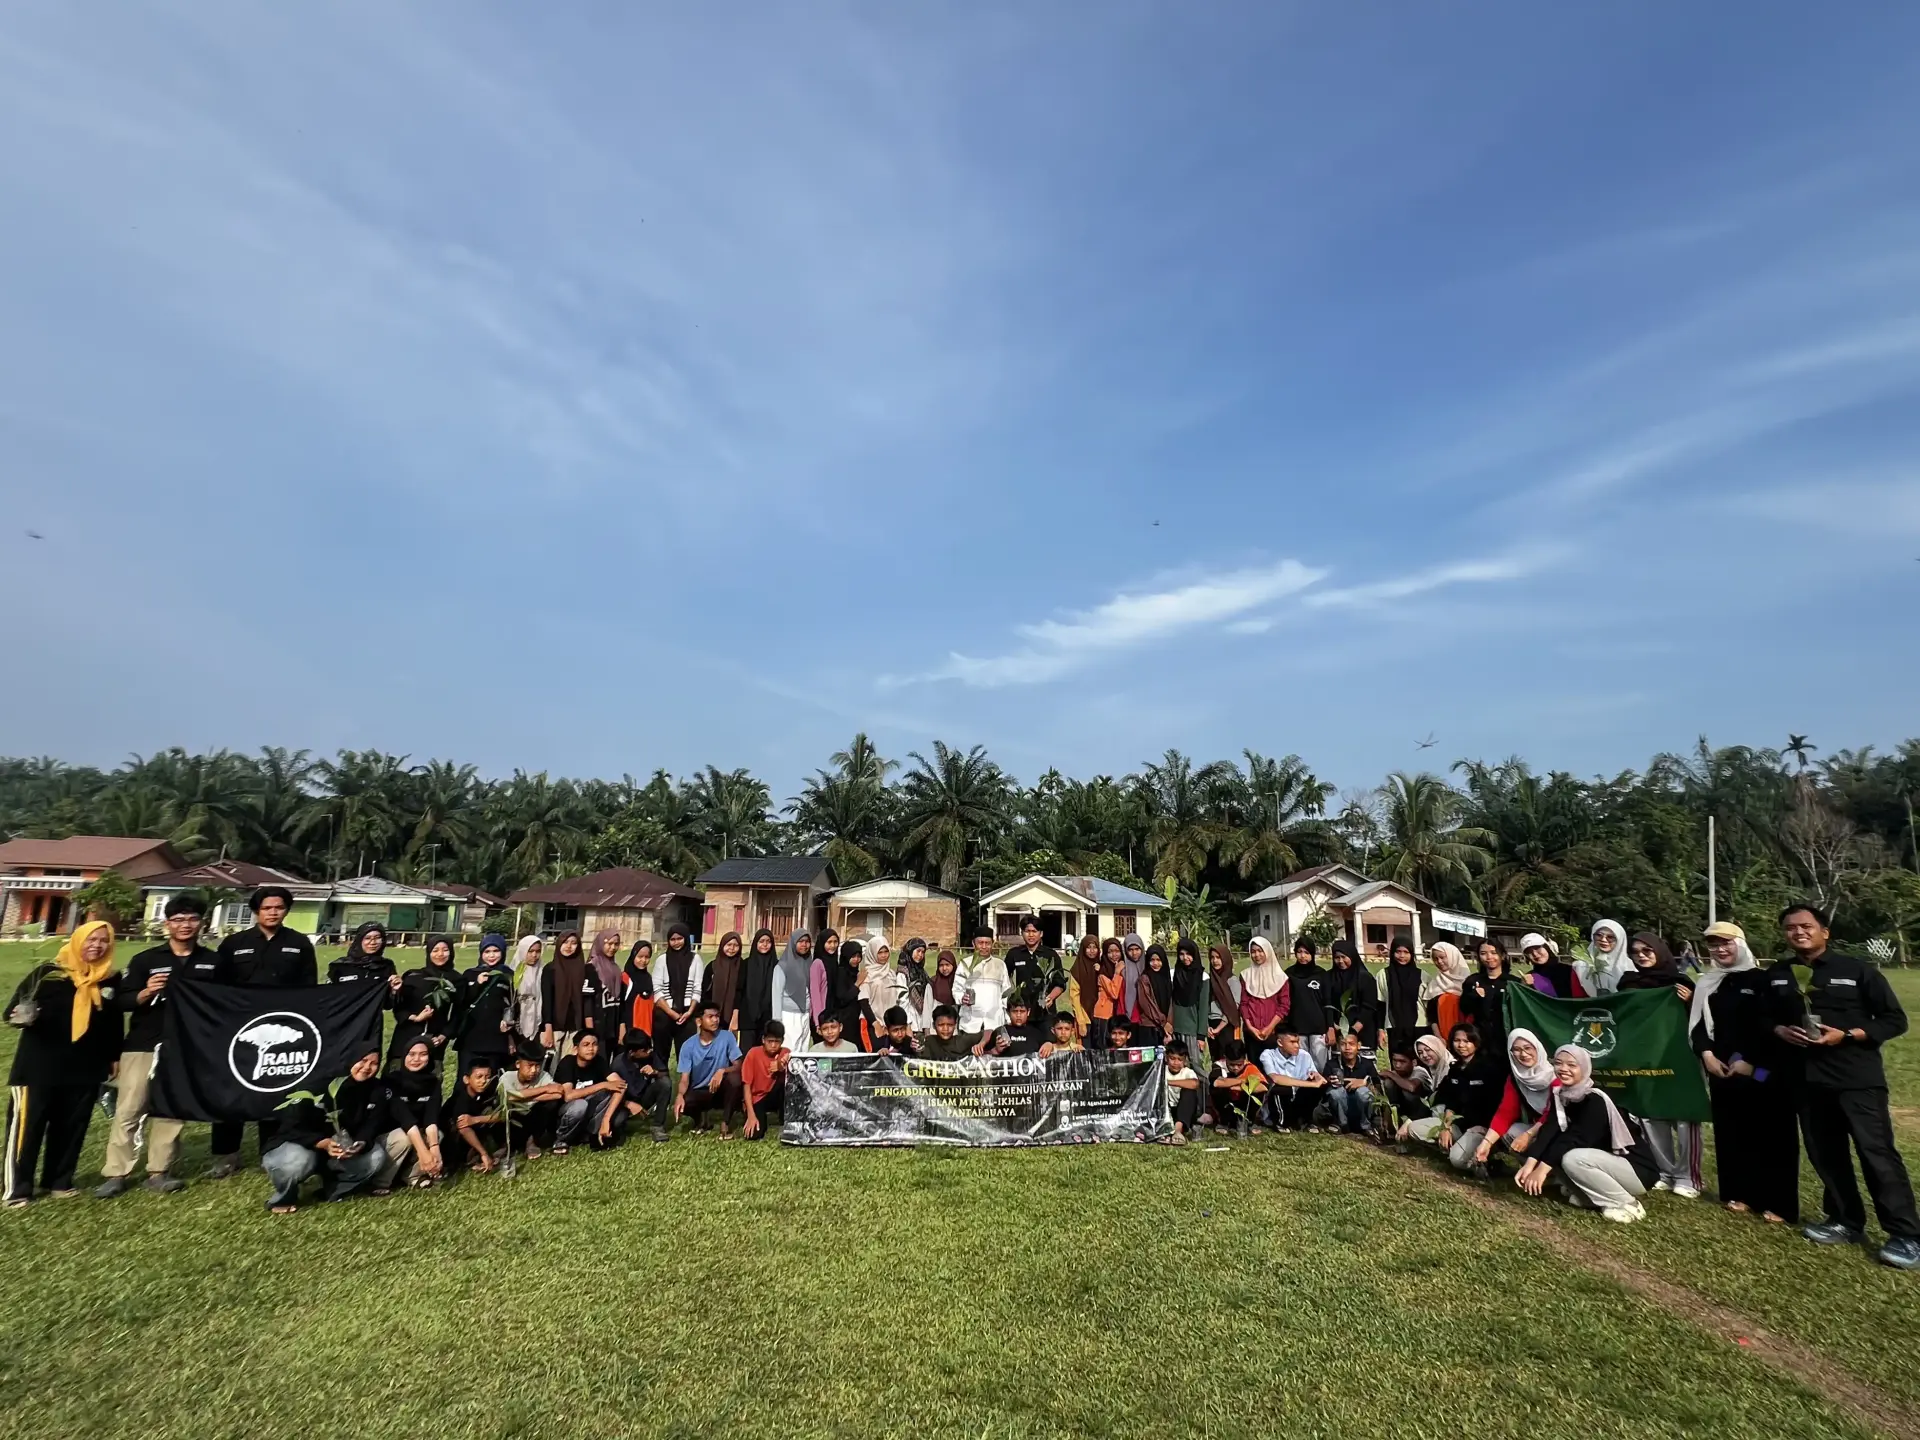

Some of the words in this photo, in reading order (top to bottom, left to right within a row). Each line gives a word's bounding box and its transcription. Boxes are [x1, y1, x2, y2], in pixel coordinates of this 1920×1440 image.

[263, 1051, 309, 1066] RAIN
[260, 1063, 310, 1077] FOREST
[903, 1060, 970, 1079] GREEN
[971, 1057, 1047, 1079] ACTION
[874, 1087, 936, 1097] PENGABDIAN
[938, 1087, 962, 1096] RAIN
[965, 1086, 1000, 1096] FOREST
[1002, 1085, 1039, 1096] MENUJU
[1040, 1082, 1083, 1093] YAYASAN
[928, 1098, 957, 1107] ISLAM
[959, 1097, 980, 1107] MTS
[981, 1096, 1032, 1107] AL-IKHLAS
[947, 1108, 982, 1118] PANTAI
[984, 1107, 1017, 1117] BUAYA
